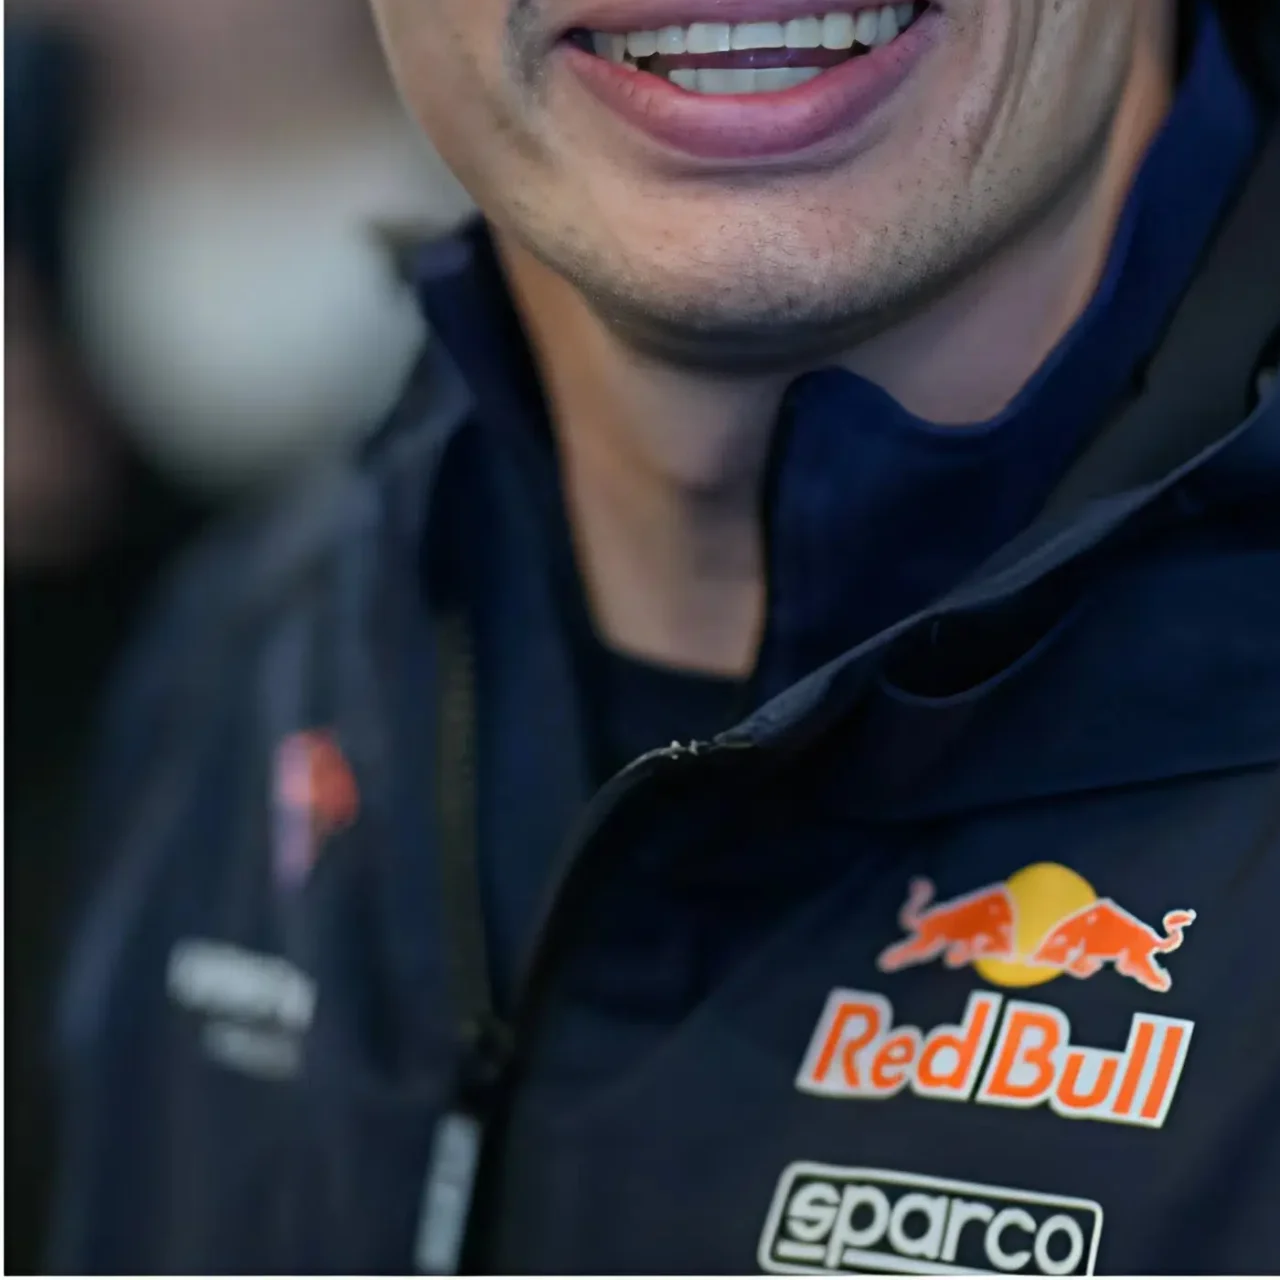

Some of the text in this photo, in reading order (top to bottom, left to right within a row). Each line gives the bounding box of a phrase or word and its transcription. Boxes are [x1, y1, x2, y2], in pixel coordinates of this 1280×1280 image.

[809, 996, 1187, 1122] Red Bull
[785, 1181, 1085, 1276] sparco
